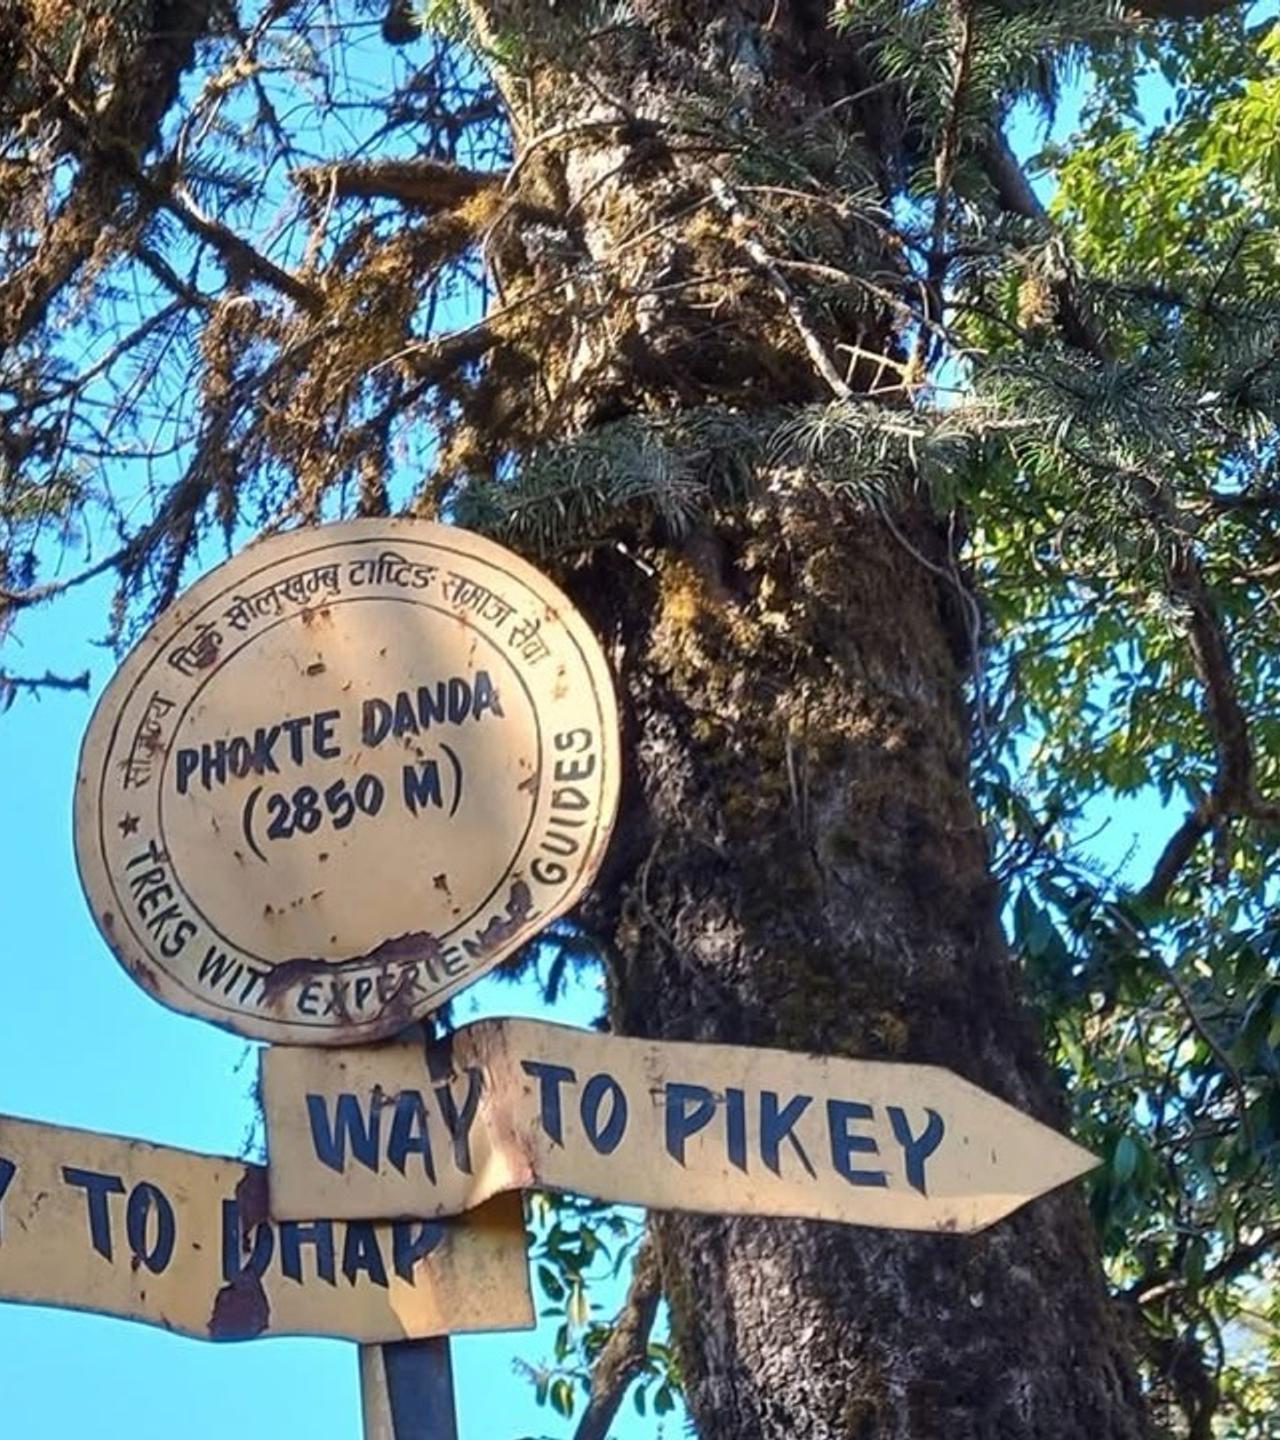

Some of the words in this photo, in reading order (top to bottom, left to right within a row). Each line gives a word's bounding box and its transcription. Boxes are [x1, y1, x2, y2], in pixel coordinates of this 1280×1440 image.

[442, 570, 517, 628] समाज
[508, 616, 551, 665] सेवा
[175, 709, 341, 795] PHOKTE
[362, 670, 505, 748] DANDA
[126, 839, 198, 958] TREKS
[529, 727, 596, 887] GUIDES
[242, 773, 385, 863] (2850
[402, 742, 463, 820] M)
[306, 1064, 482, 1187] WAY
[521, 1059, 629, 1157] TO
[664, 1081, 947, 1196] PIKEY
[62, 1165, 177, 1276] TO
